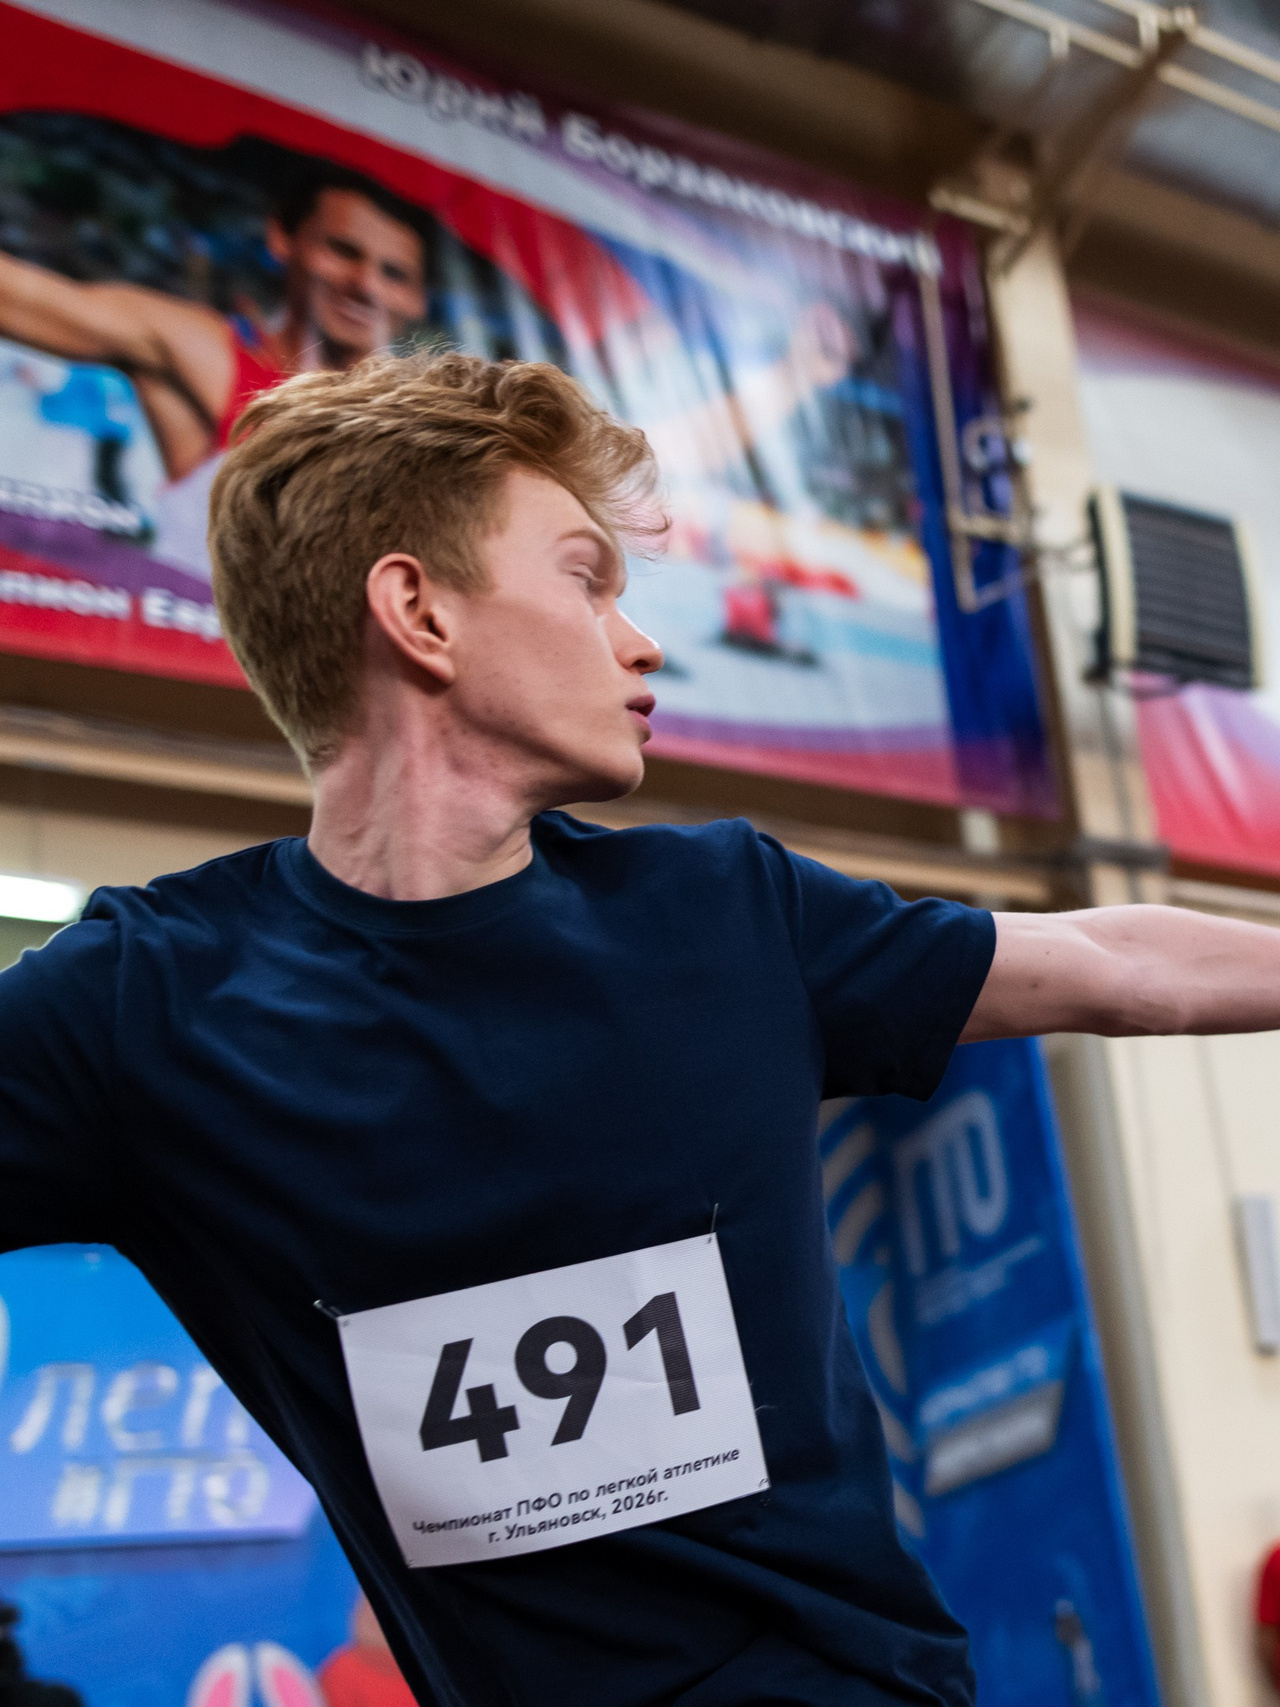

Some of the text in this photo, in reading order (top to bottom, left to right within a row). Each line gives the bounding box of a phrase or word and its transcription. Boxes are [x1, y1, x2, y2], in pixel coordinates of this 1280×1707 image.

[0, 570, 131, 621] пион
[419, 1291, 701, 1463] 491
[412, 1449, 740, 1534] Чемпионат ПФО по легкой атлетике
[487, 1489, 668, 1544] г. Ульяновск, 2026г.
